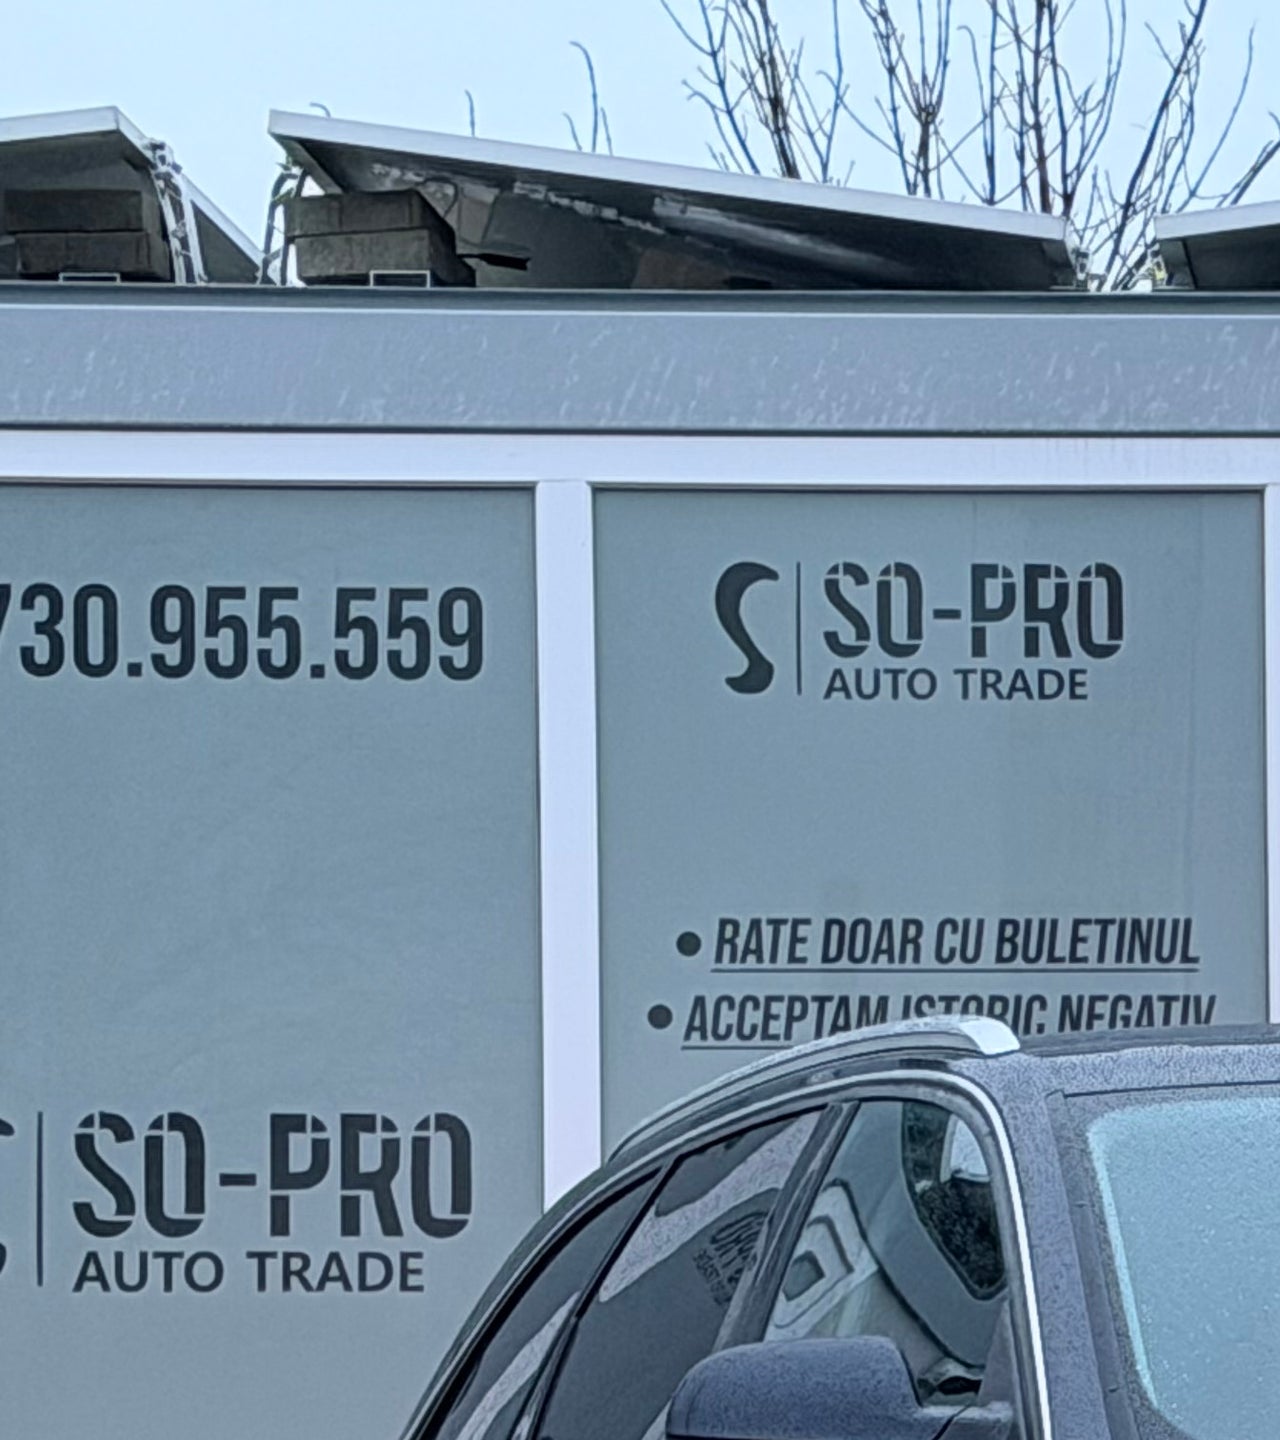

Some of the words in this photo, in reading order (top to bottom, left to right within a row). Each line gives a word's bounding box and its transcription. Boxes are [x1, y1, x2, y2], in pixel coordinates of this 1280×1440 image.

[823, 561, 1124, 659] SO-PRO
[823, 668, 937, 701] AUTO
[954, 668, 1088, 700] TRADE
[714, 917, 812, 965] RATE
[821, 918, 924, 965] DOAR
[933, 917, 985, 965] CU
[994, 917, 1200, 965] BULETINUL
[683, 994, 890, 1041] ACCEPTAM
[73, 1111, 472, 1239] SO-PRO
[72, 1250, 224, 1293] AUTO
[246, 1250, 425, 1293] TRADE
